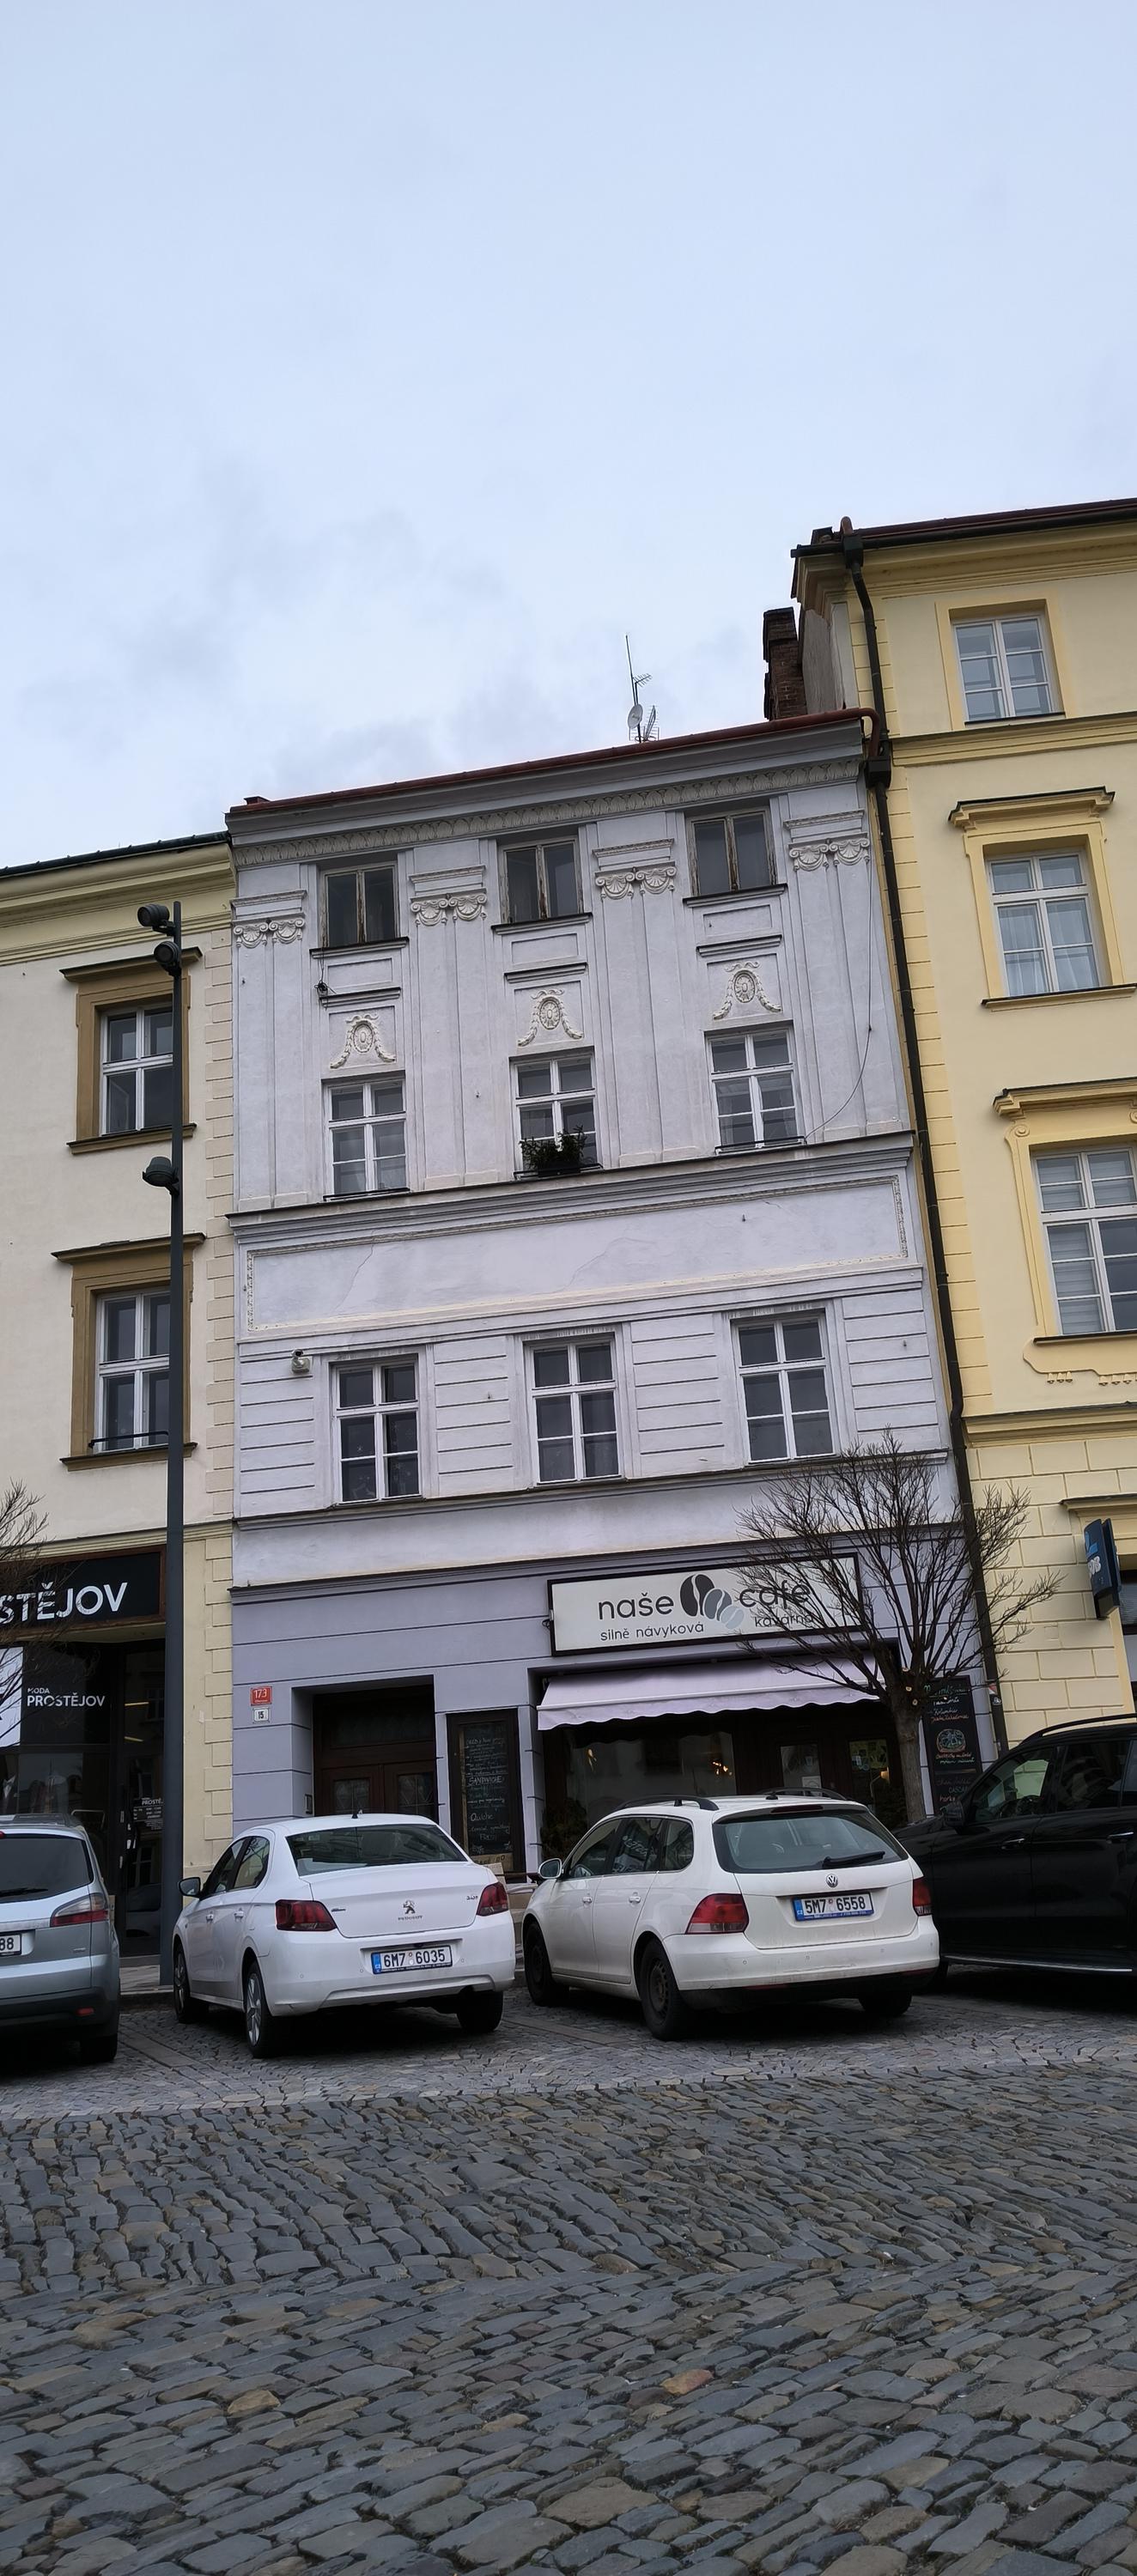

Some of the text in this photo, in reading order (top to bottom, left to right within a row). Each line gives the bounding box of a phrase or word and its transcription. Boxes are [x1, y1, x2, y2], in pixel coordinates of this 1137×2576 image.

[598, 1578, 811, 1620] naše café
[600, 1628, 629, 1641] silně
[636, 1621, 704, 1638] návyková
[27, 1692, 106, 1707] PROSTĚJOV
[253, 1688, 267, 1699] 173
[258, 1710, 264, 1720] 15
[804, 1896, 866, 1914] 5M7 6558
[383, 1953, 405, 1968] 6M7
[415, 1949, 446, 1965] 6035
